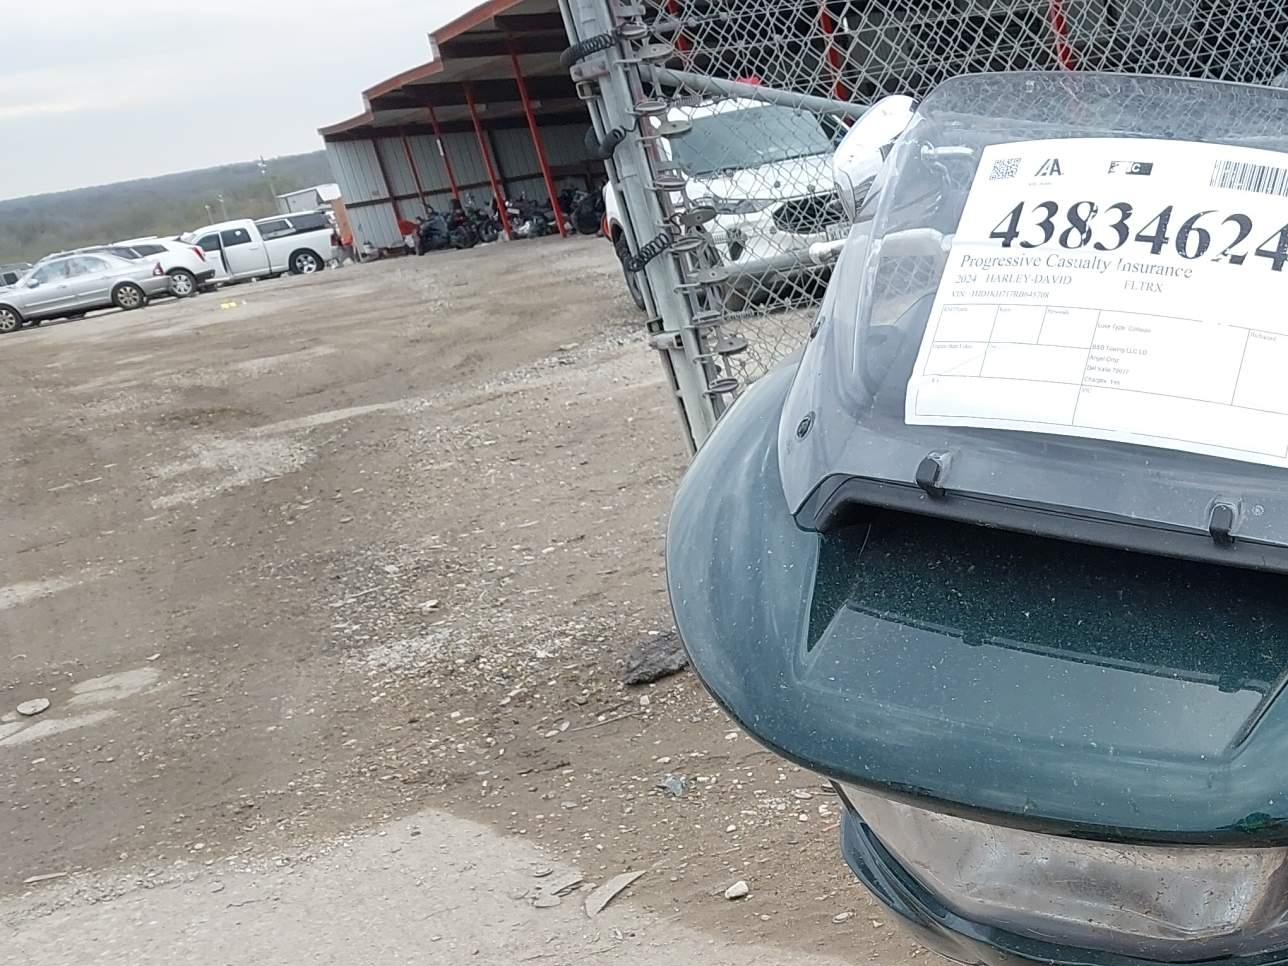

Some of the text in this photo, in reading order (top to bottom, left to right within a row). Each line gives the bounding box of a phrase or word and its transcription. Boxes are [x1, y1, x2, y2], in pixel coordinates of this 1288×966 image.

[960, 253, 1193, 279] Progressive Casualty Insurance
[952, 273, 1073, 285] 2024 HARLEY-DAVID
